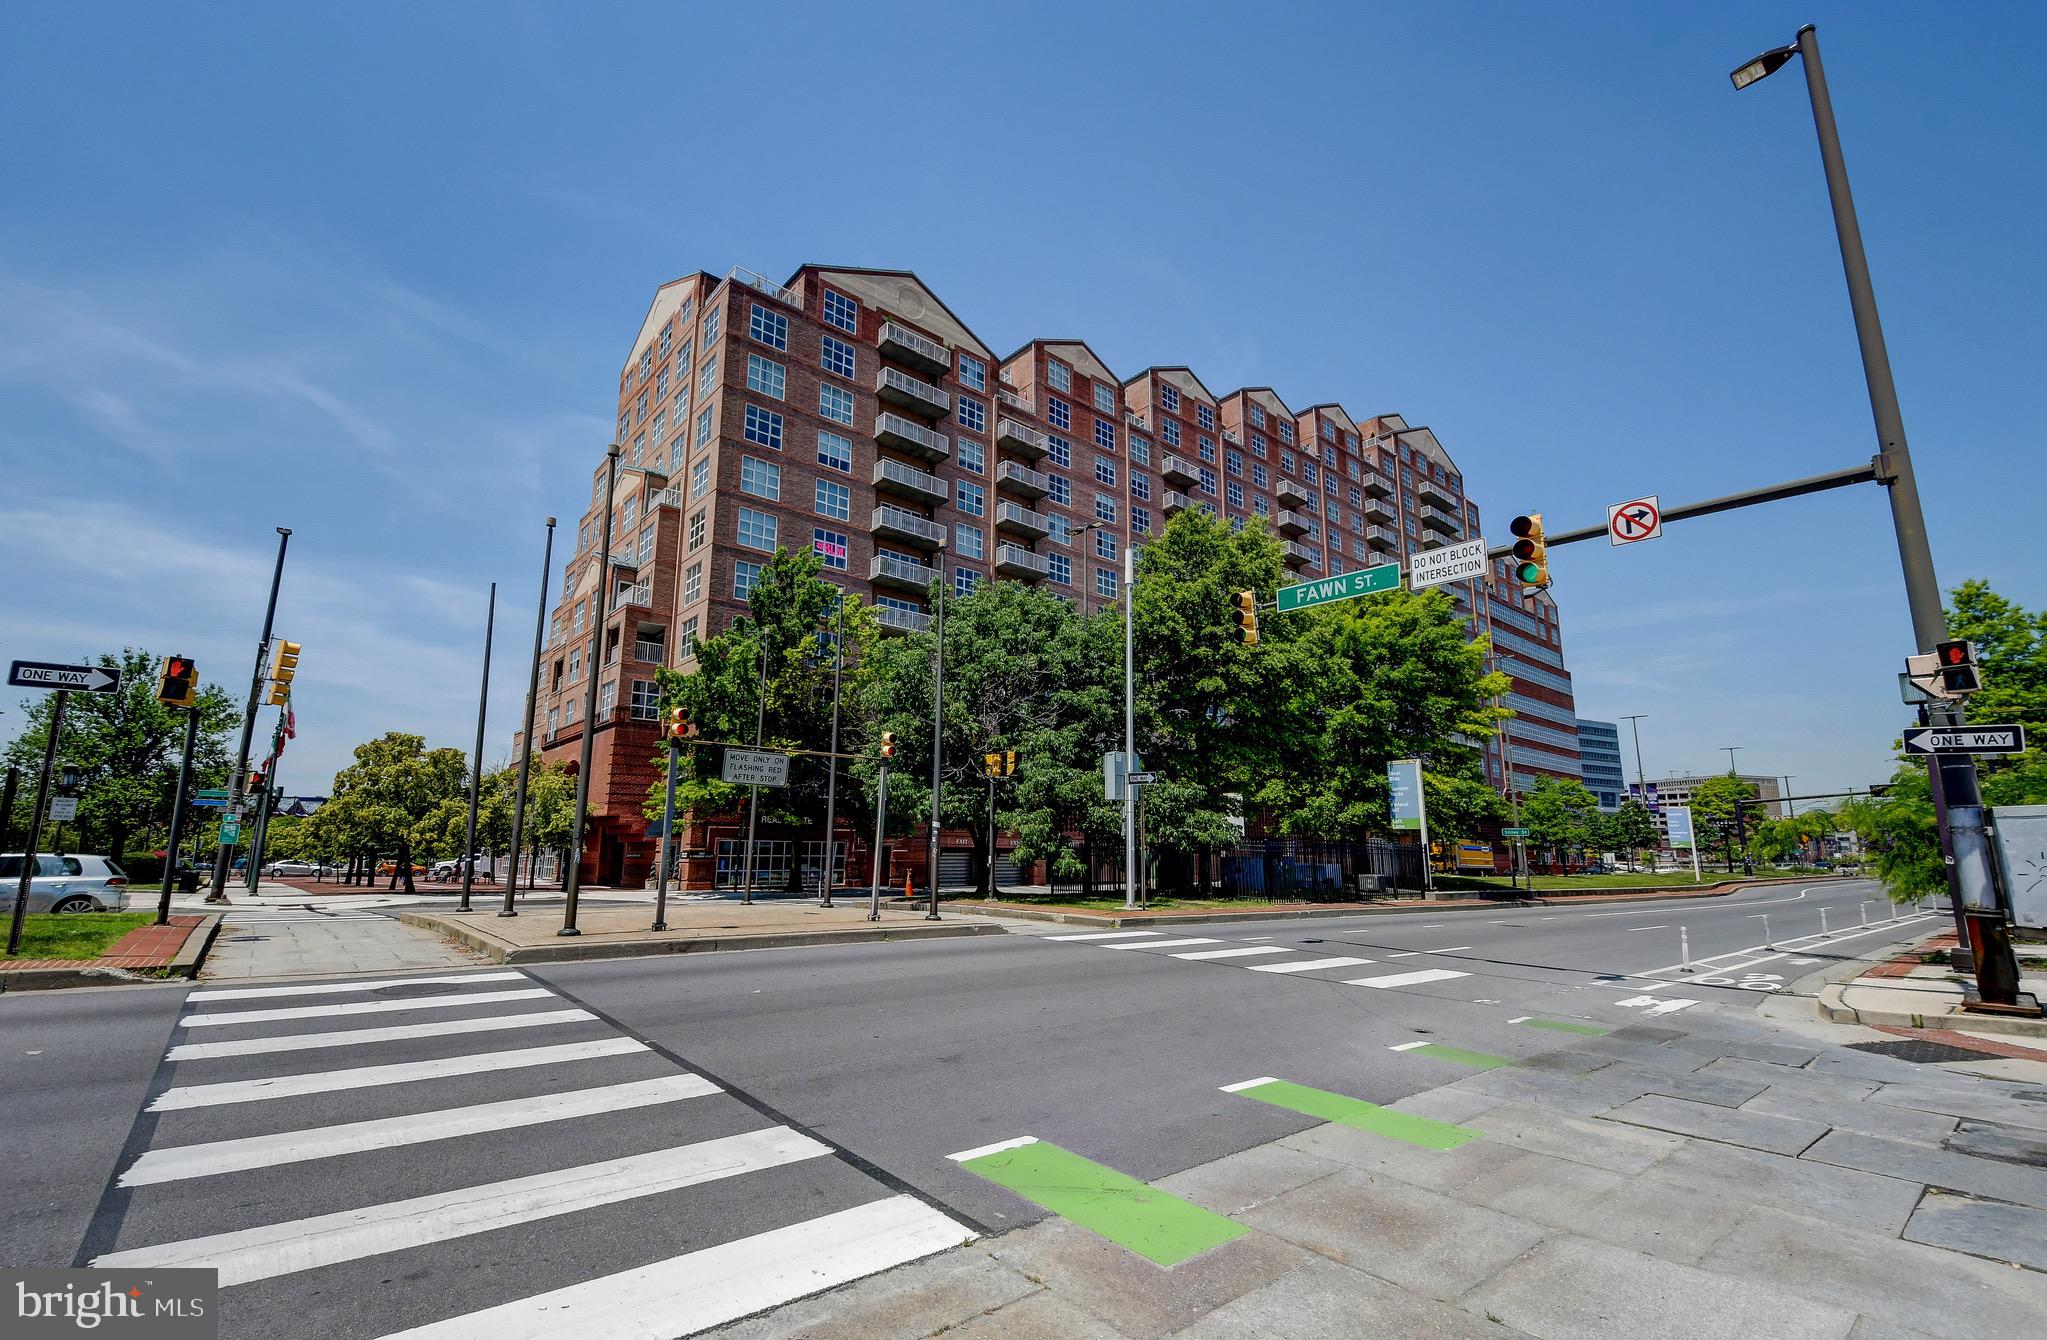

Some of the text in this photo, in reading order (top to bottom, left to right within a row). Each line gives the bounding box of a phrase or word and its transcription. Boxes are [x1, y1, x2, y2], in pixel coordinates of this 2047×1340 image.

[1414, 543, 1482, 569] DO NOT BLOCK
[1416, 559, 1481, 583] INTERSECTION
[1296, 574, 1377, 603] FAWN ST.
[22, 668, 88, 683] ONE WAY
[1930, 733, 2009, 746] ONE WAY
[729, 753, 784, 765] MOVE ONLY ON
[729, 763, 782, 774] FLASHING RED
[732, 773, 777, 783] AFTER STOP
[761, 815, 782, 824] REAL
